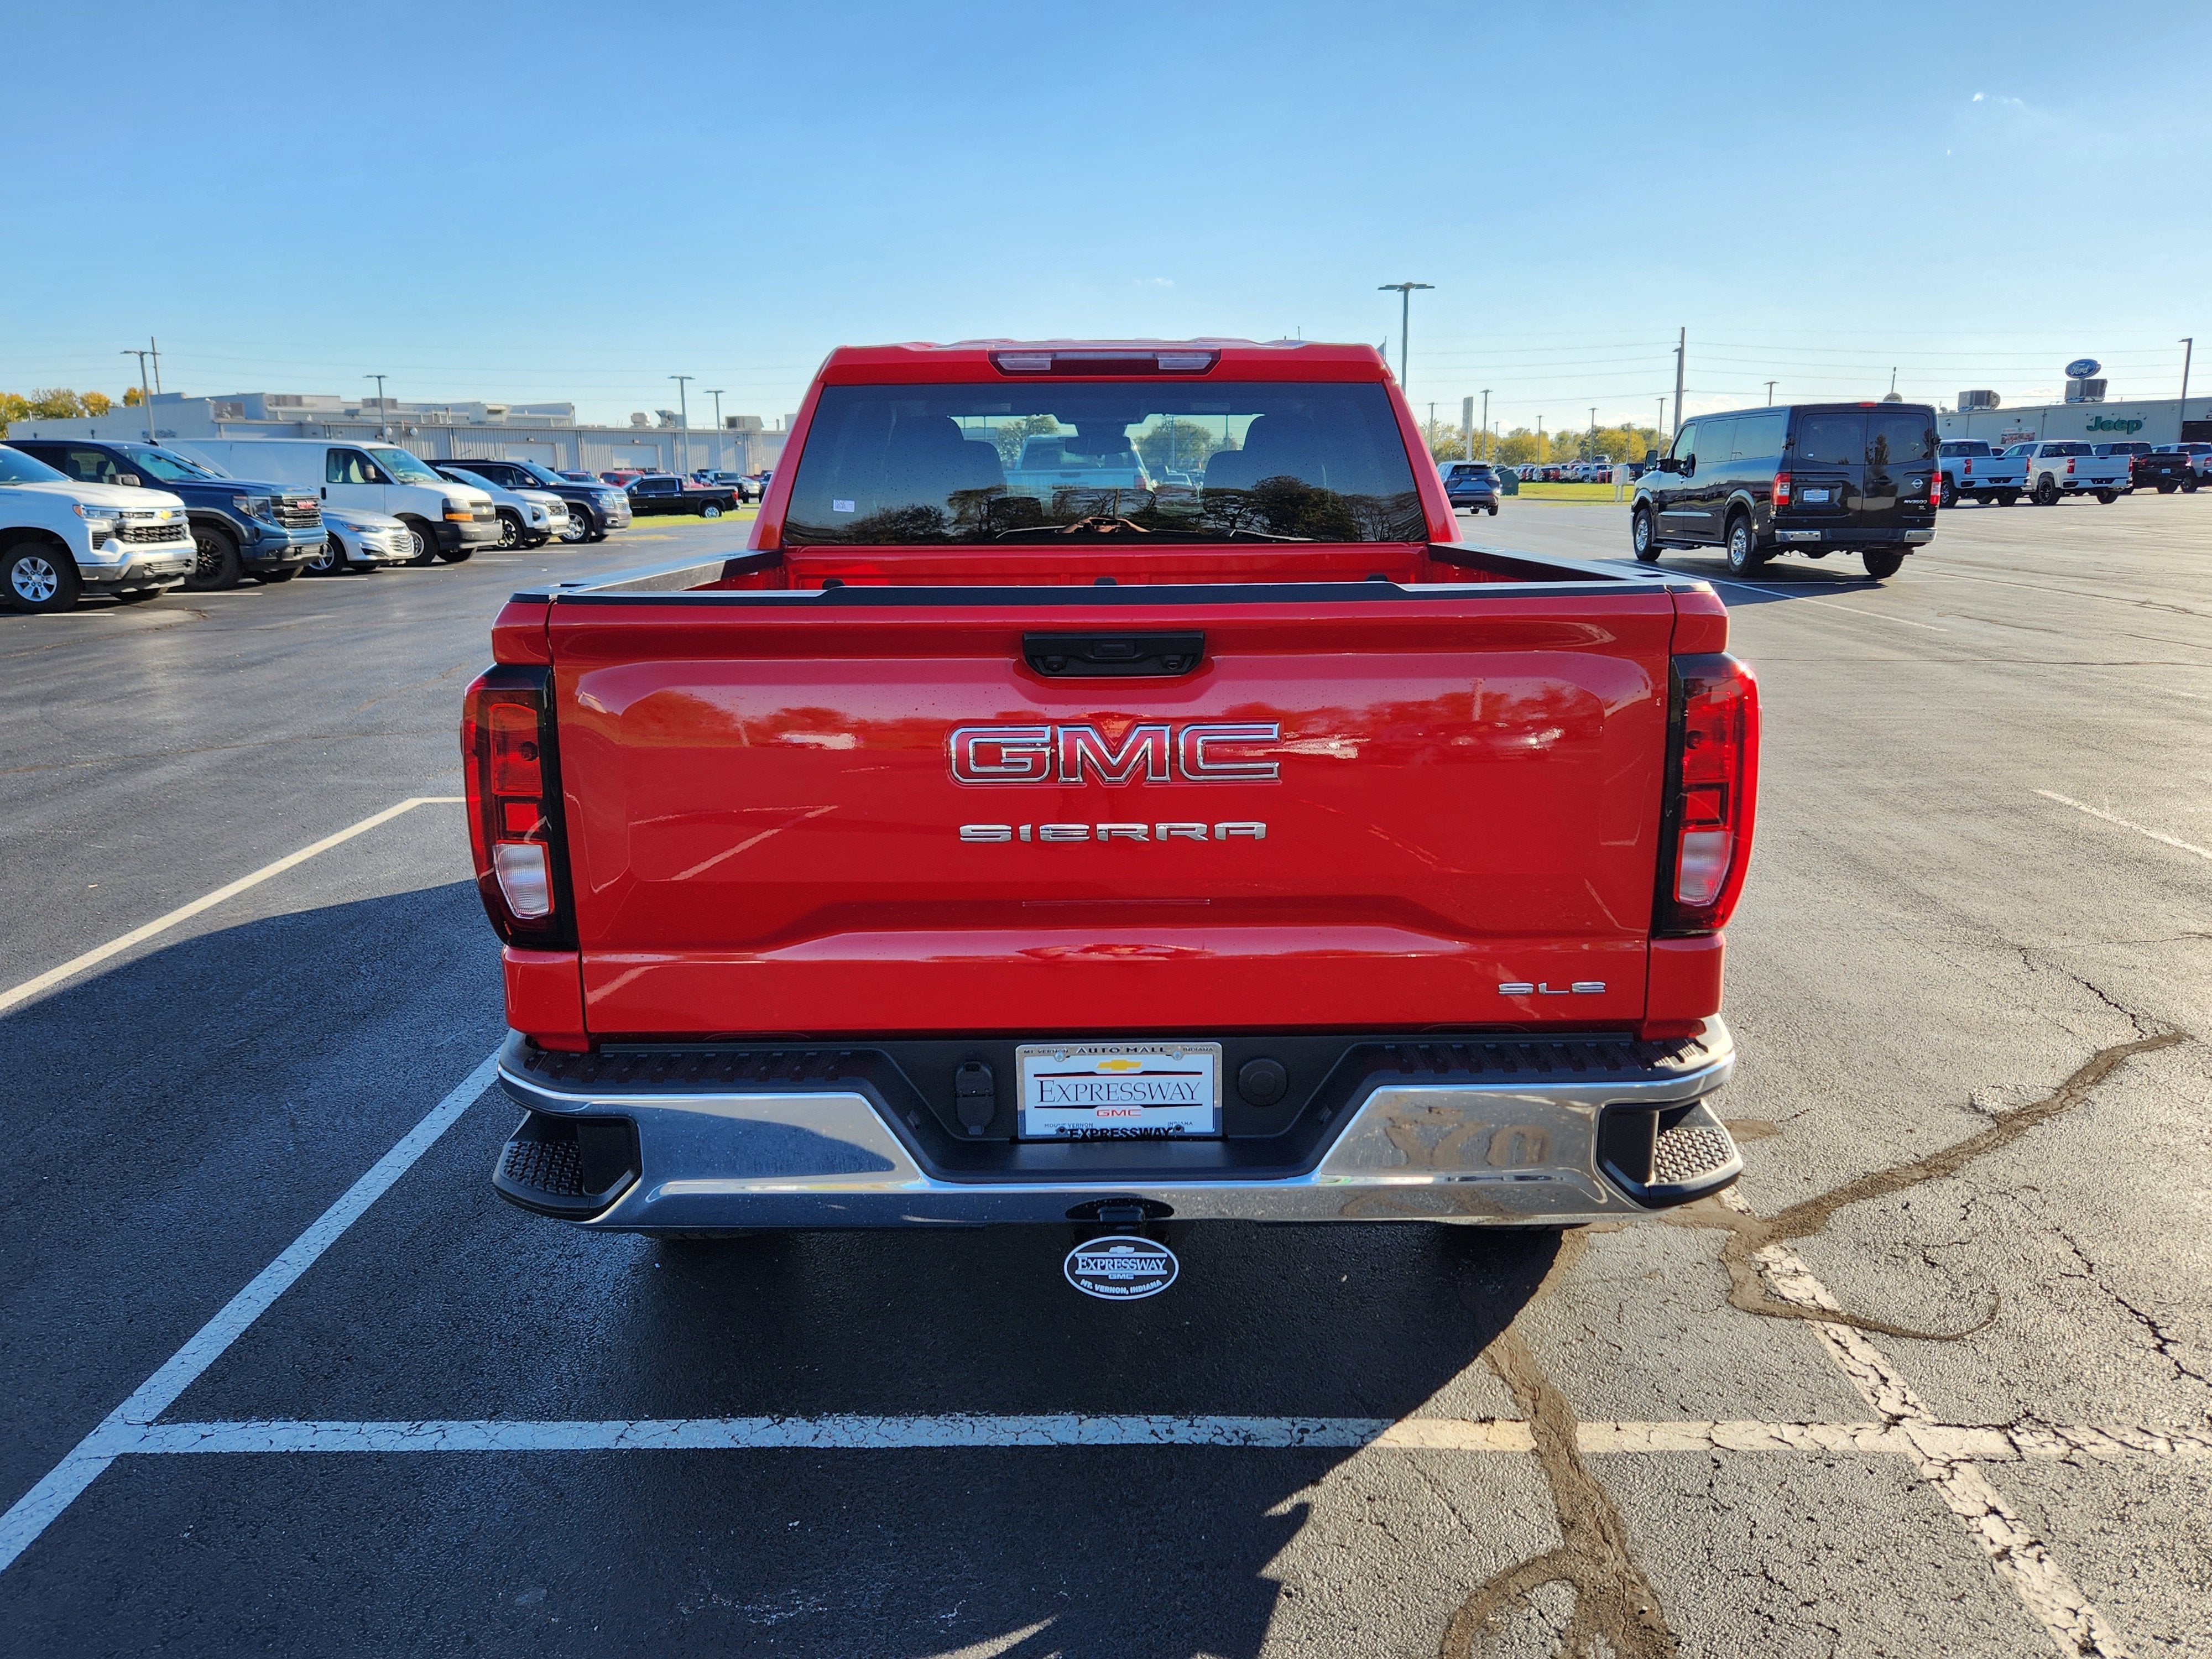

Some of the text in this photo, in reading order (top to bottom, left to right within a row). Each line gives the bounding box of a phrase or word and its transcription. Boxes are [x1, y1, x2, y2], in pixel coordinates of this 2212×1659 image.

[2070, 362, 2090, 375] Ford
[2086, 416, 2143, 435] Jeep
[950, 723, 1280, 784] GMC
[959, 821, 1267, 843] SIERRA
[1498, 982, 1606, 995] SLE
[1037, 1079, 1201, 1103] EXPRESSWAY
[1096, 1109, 1142, 1117] GMC
[1069, 1127, 1173, 1139] EXPRESSWAY
[1077, 1256, 1166, 1270] EXPRESSWAY
[1095, 1283, 1129, 1295] VERNON,
[1130, 1279, 1162, 1293] INDIANA
